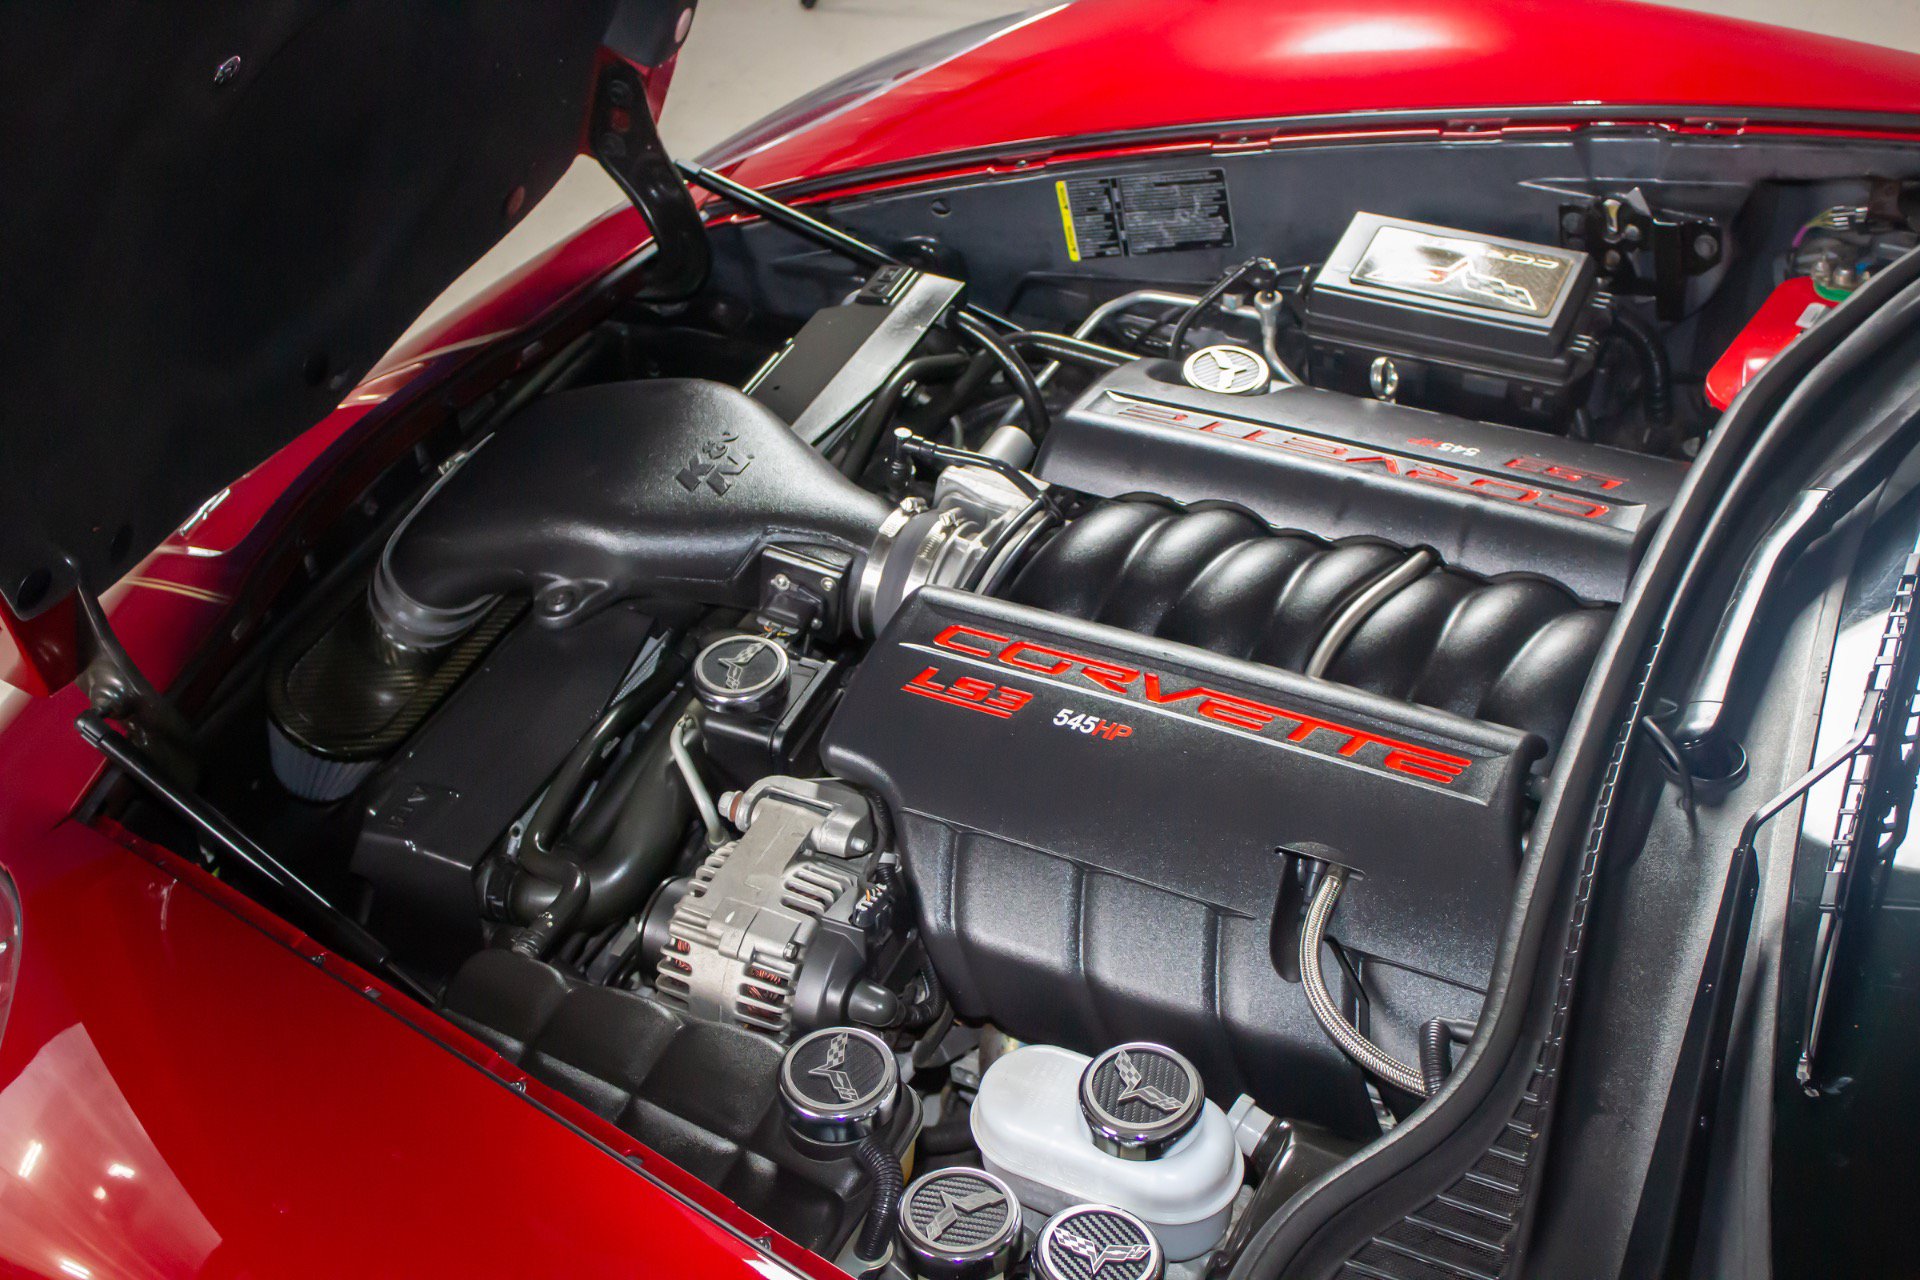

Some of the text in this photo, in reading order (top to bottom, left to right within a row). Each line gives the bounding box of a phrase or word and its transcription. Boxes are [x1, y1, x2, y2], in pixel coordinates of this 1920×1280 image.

[1118, 405, 1610, 519] CORVETTE
[905, 666, 1034, 714] LS3
[933, 624, 1472, 784] CORVETTE
[1052, 708, 1133, 741] 545HP
